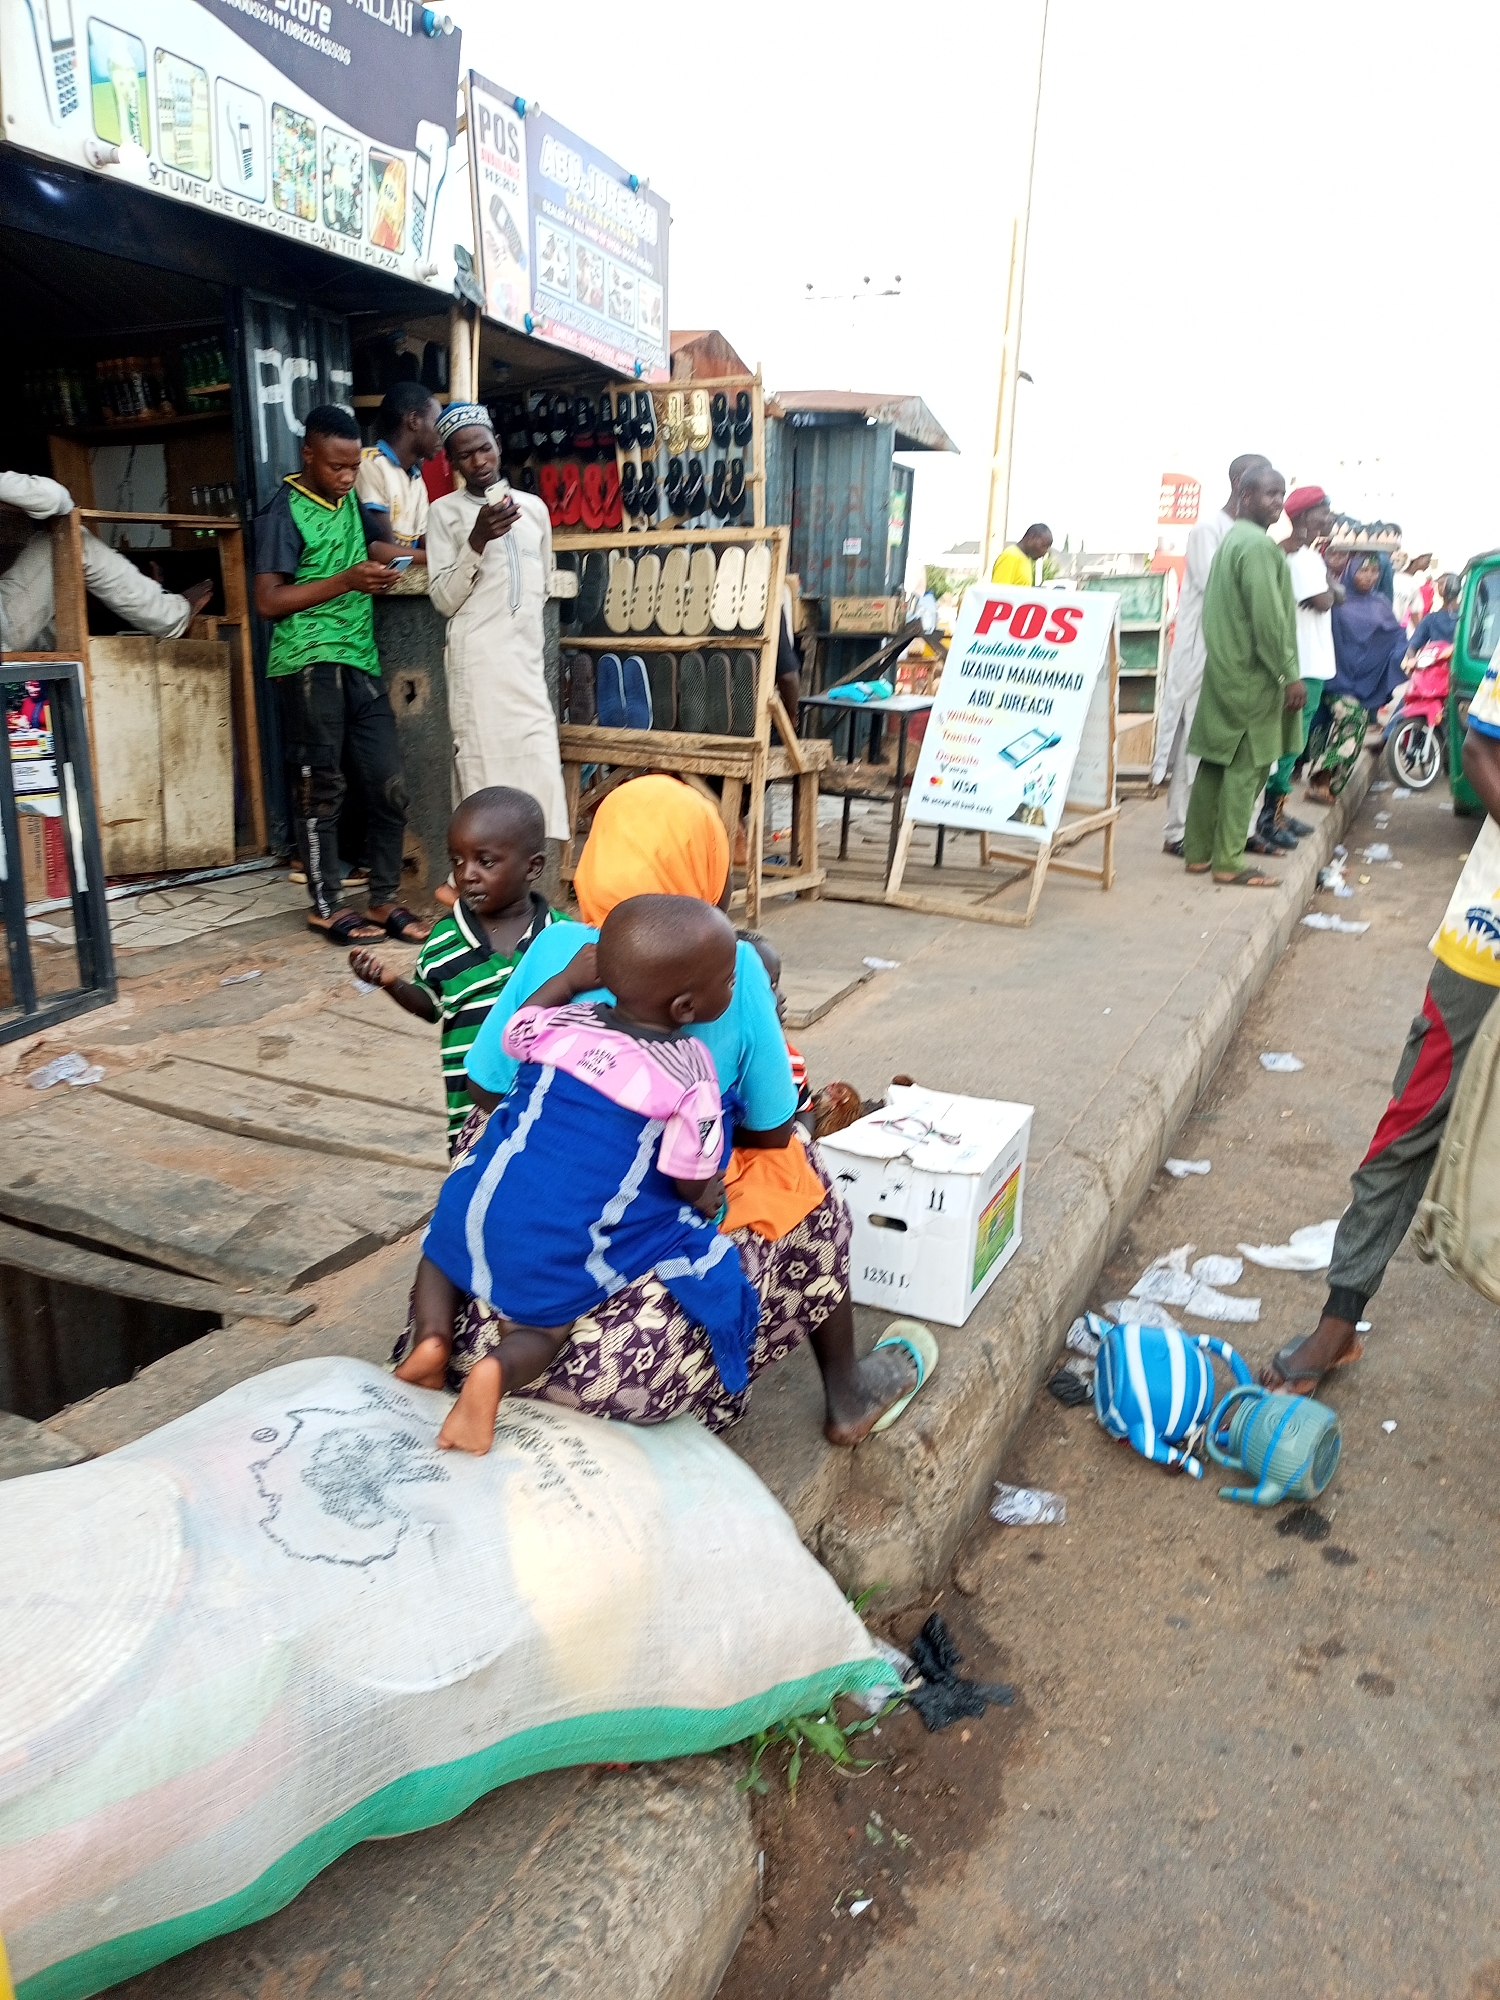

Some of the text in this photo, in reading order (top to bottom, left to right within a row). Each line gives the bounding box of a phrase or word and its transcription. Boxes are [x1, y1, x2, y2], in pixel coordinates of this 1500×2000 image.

[479, 103, 520, 163] POS
[157, 169, 401, 269] TUMFURE OPPOSITE DAN TITI PLAZA
[973, 600, 1084, 644] POS
[966, 640, 1059, 661] Available Here
[960, 659, 1084, 692] UZAIRU MAHAMMAD
[967, 688, 1055, 717] ABU JUREACH
[952, 779, 978, 795] VISA
